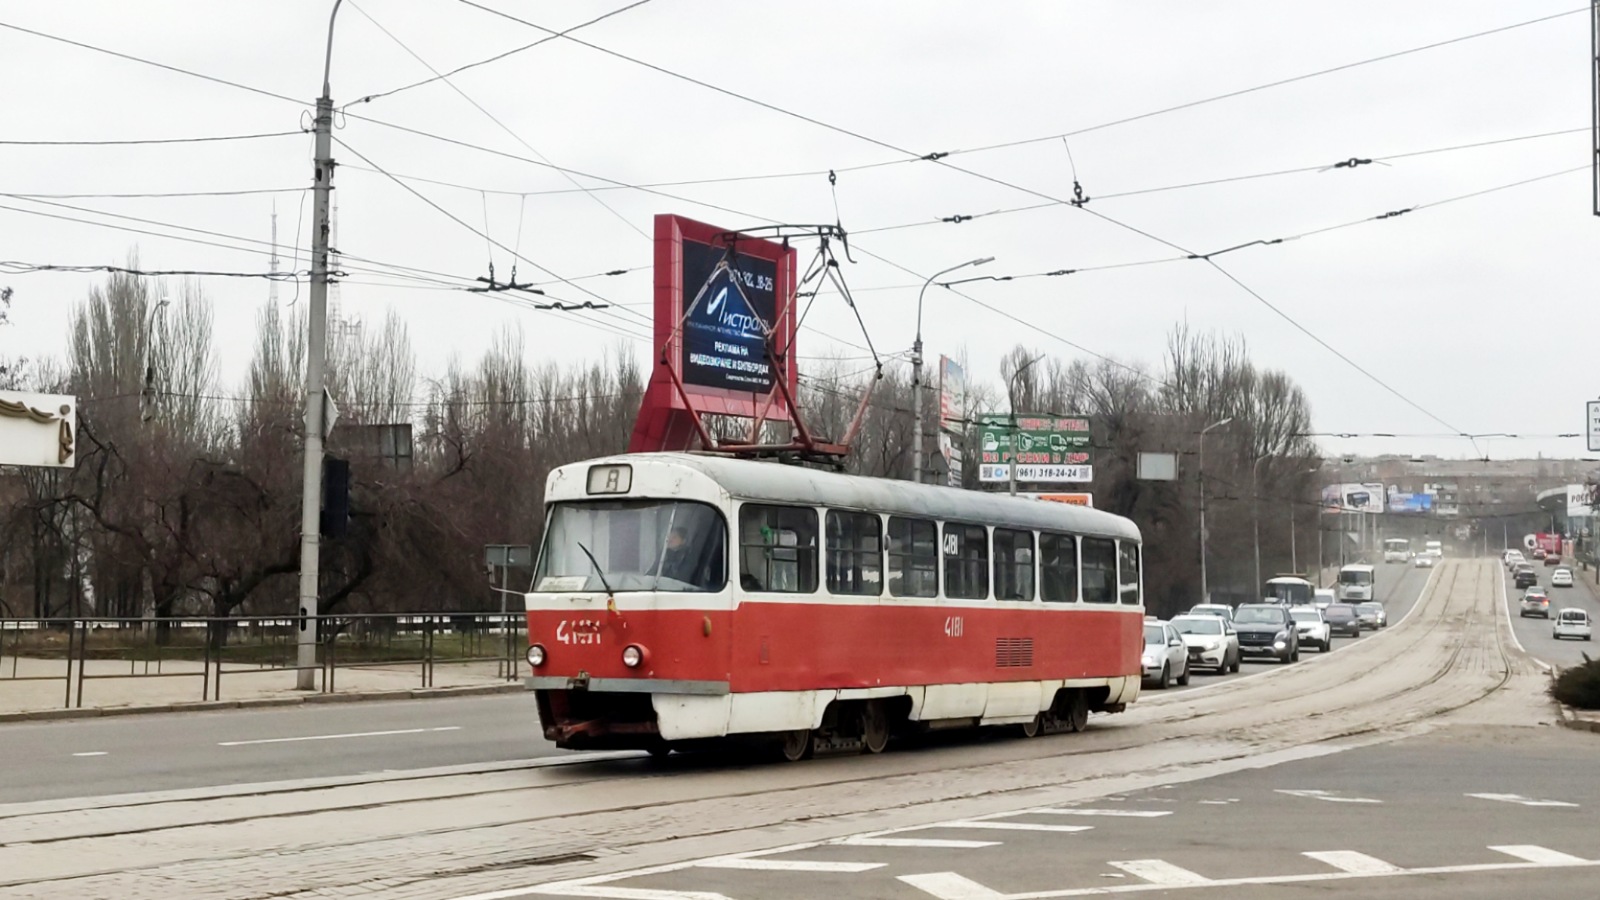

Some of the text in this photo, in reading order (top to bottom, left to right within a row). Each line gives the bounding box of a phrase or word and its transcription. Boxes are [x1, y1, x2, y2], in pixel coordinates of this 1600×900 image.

[714, 341, 740, 354] РЕКЛАМА
[1002, 452, 1050, 463] РССИИ
[1038, 468, 1077, 478] 318-24-24
[943, 533, 959, 555] 4181
[944, 616, 964, 638] 4181
